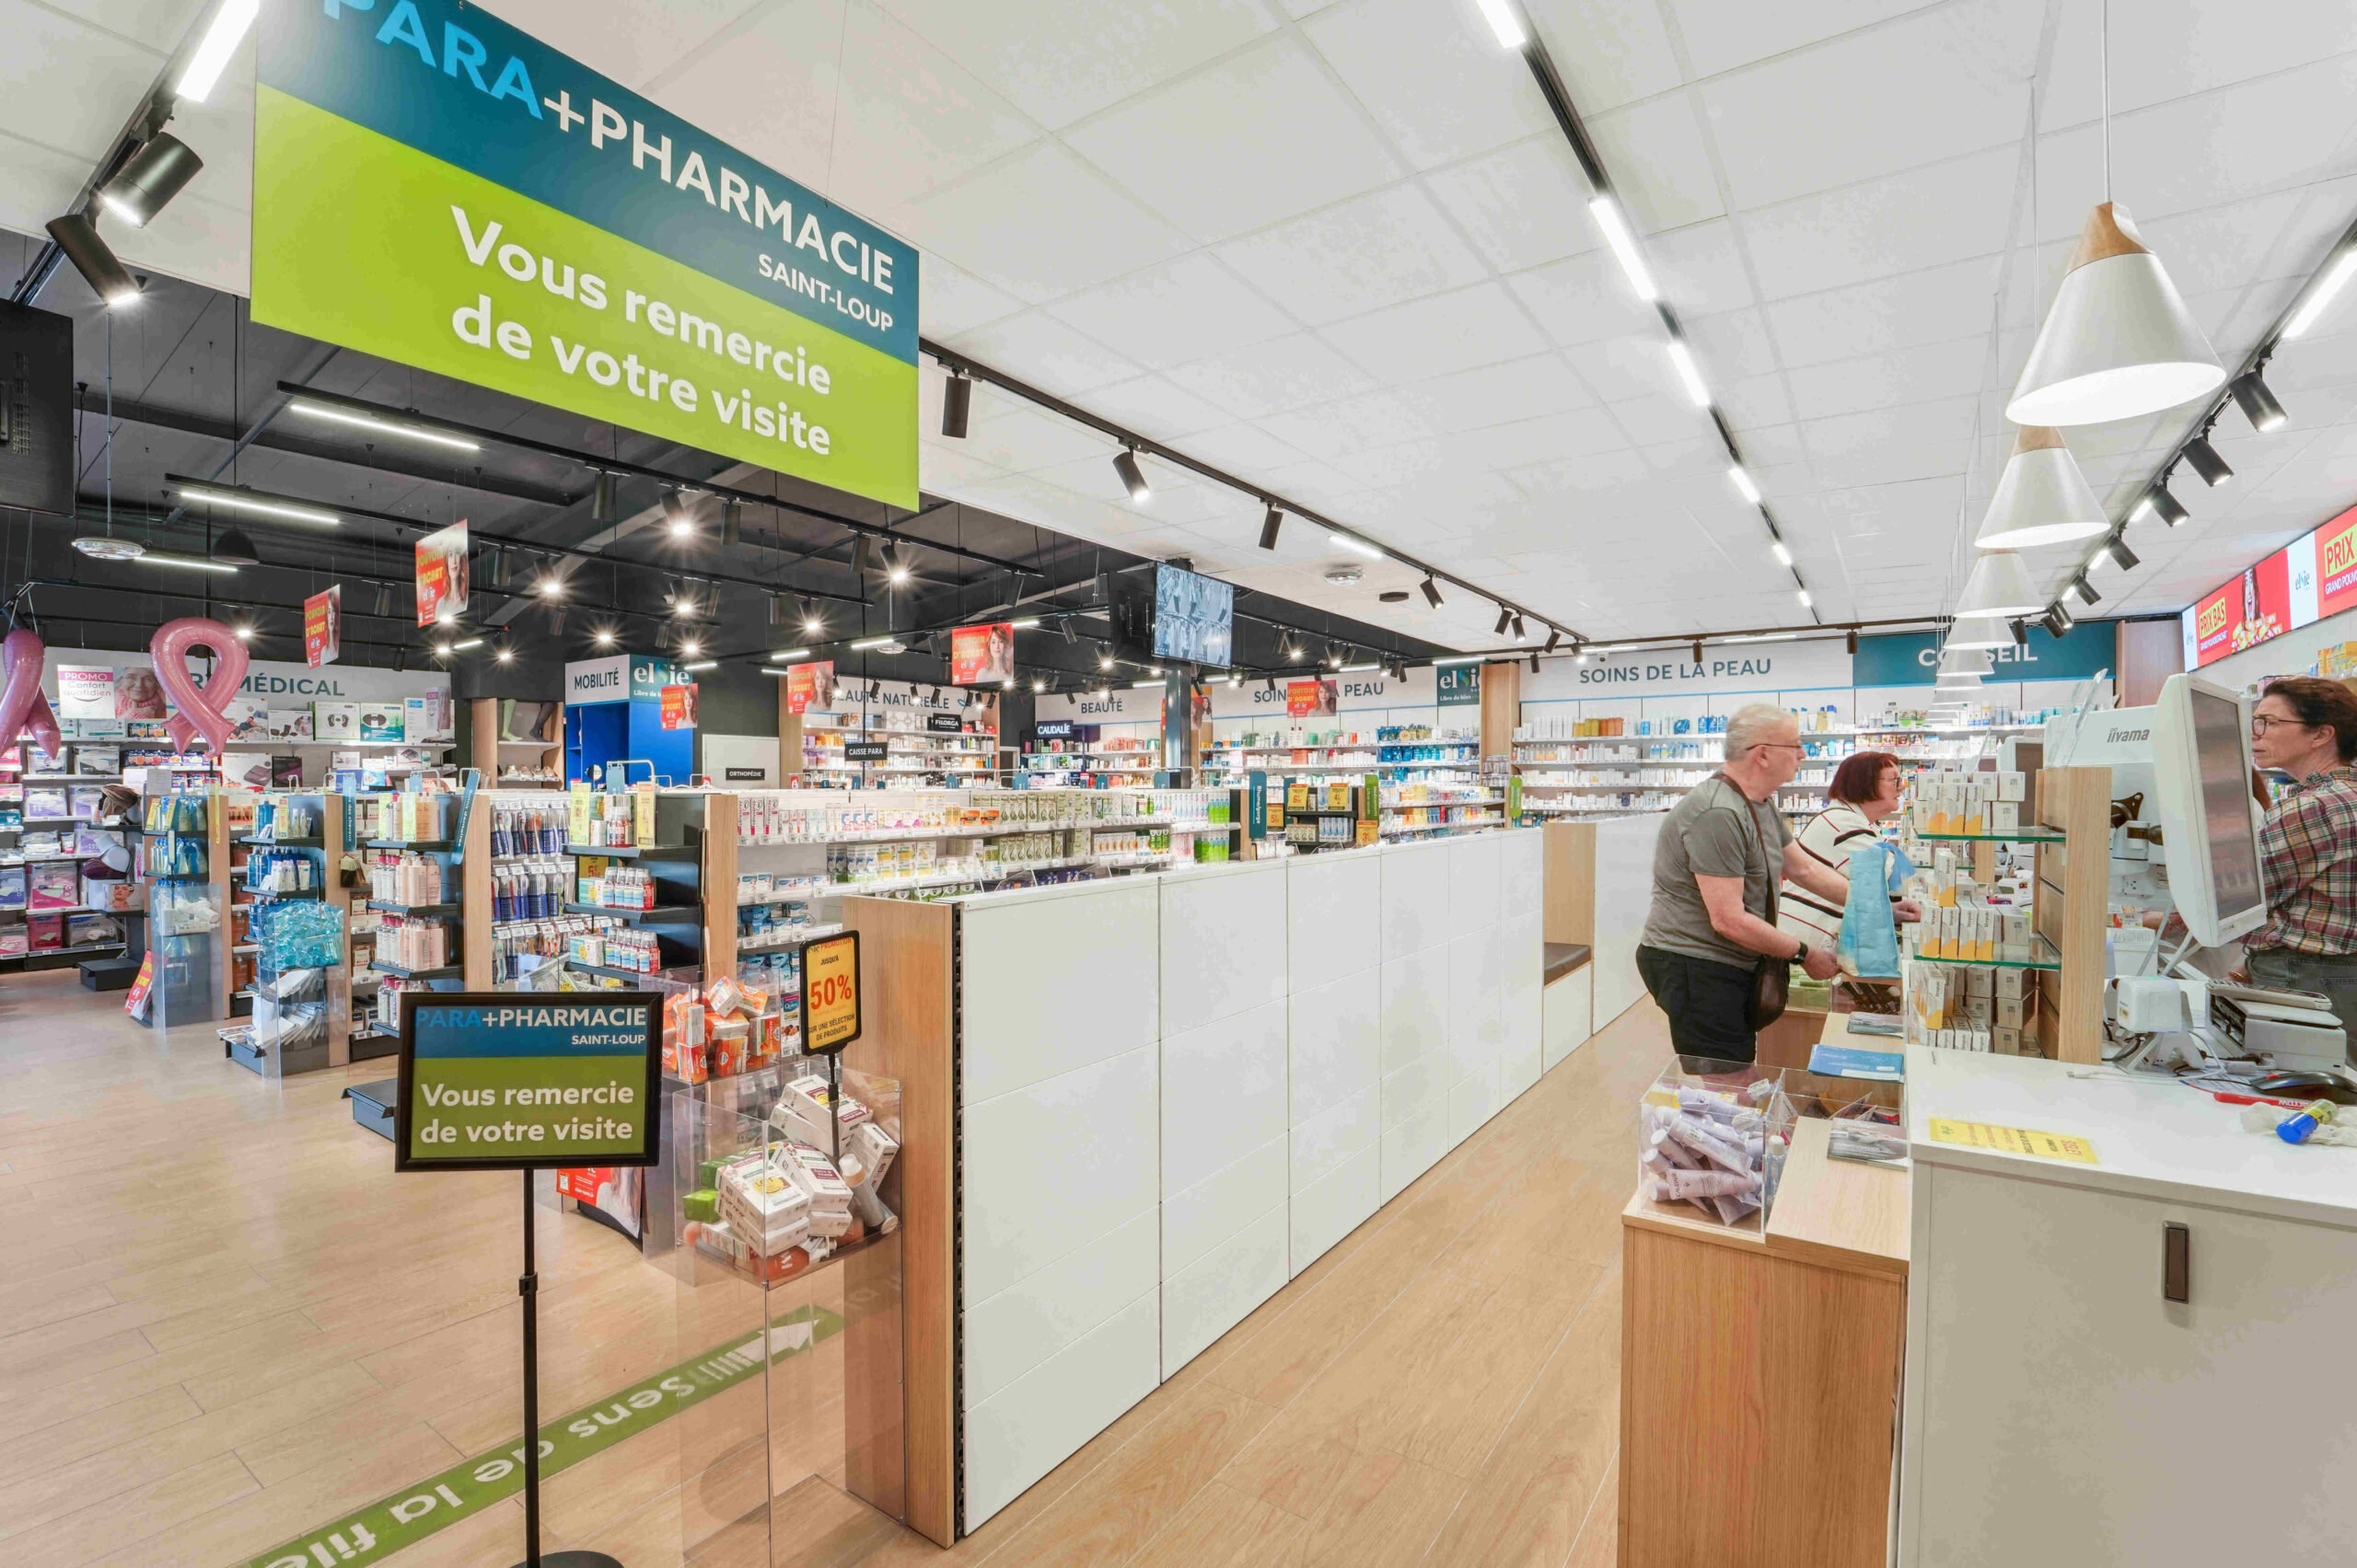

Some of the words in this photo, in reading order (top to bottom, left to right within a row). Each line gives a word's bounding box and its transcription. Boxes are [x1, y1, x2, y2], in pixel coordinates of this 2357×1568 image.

[450, 204, 608, 311] Vous
[625, 285, 831, 396] remercie
[758, 253, 894, 333] SAINT-LOUP
[452, 294, 532, 361] de
[550, 333, 699, 414] votre
[712, 388, 831, 456] visite
[2326, 531, 2355, 575] PRIX
[1918, 644, 2038, 667] CSEIL
[64, 672, 108, 681] PROMO
[574, 667, 620, 691] MOBILITÉ
[1579, 667, 1640, 684] SOINS
[1646, 664, 1673, 680] DE
[1679, 662, 1706, 679] LA
[1713, 658, 1771, 677] PEAU
[67, 681, 106, 690] Confort
[1254, 689, 1287, 703] SOIN
[1343, 682, 1384, 697] PEAU
[882, 692, 949, 709] NATUELE
[1081, 698, 1123, 714] BEAUTÉ
[2107, 726, 2151, 743] iiyama
[848, 748, 867, 756] CAISSE
[810, 973, 853, 1010] 50%
[414, 1007, 646, 1028] PARA+PHARMACIE
[808, 1025, 818, 1034] SUR
[818, 1022, 829, 1031] UNE
[829, 1013, 855, 1026] SÉLECTION
[571, 1034, 646, 1045] SAINT-LOUP
[816, 1033, 823, 1041] DE
[823, 1025, 848, 1040] PRODUITS
[421, 1083, 495, 1107] Vous
[505, 1080, 634, 1106] remercie
[420, 1118, 458, 1144] de
[465, 1121, 545, 1143] votre
[552, 1116, 633, 1141] visite
[567, 1376, 696, 1438] Sens
[472, 1439, 554, 1482] de
[389, 1483, 464, 1525] la
